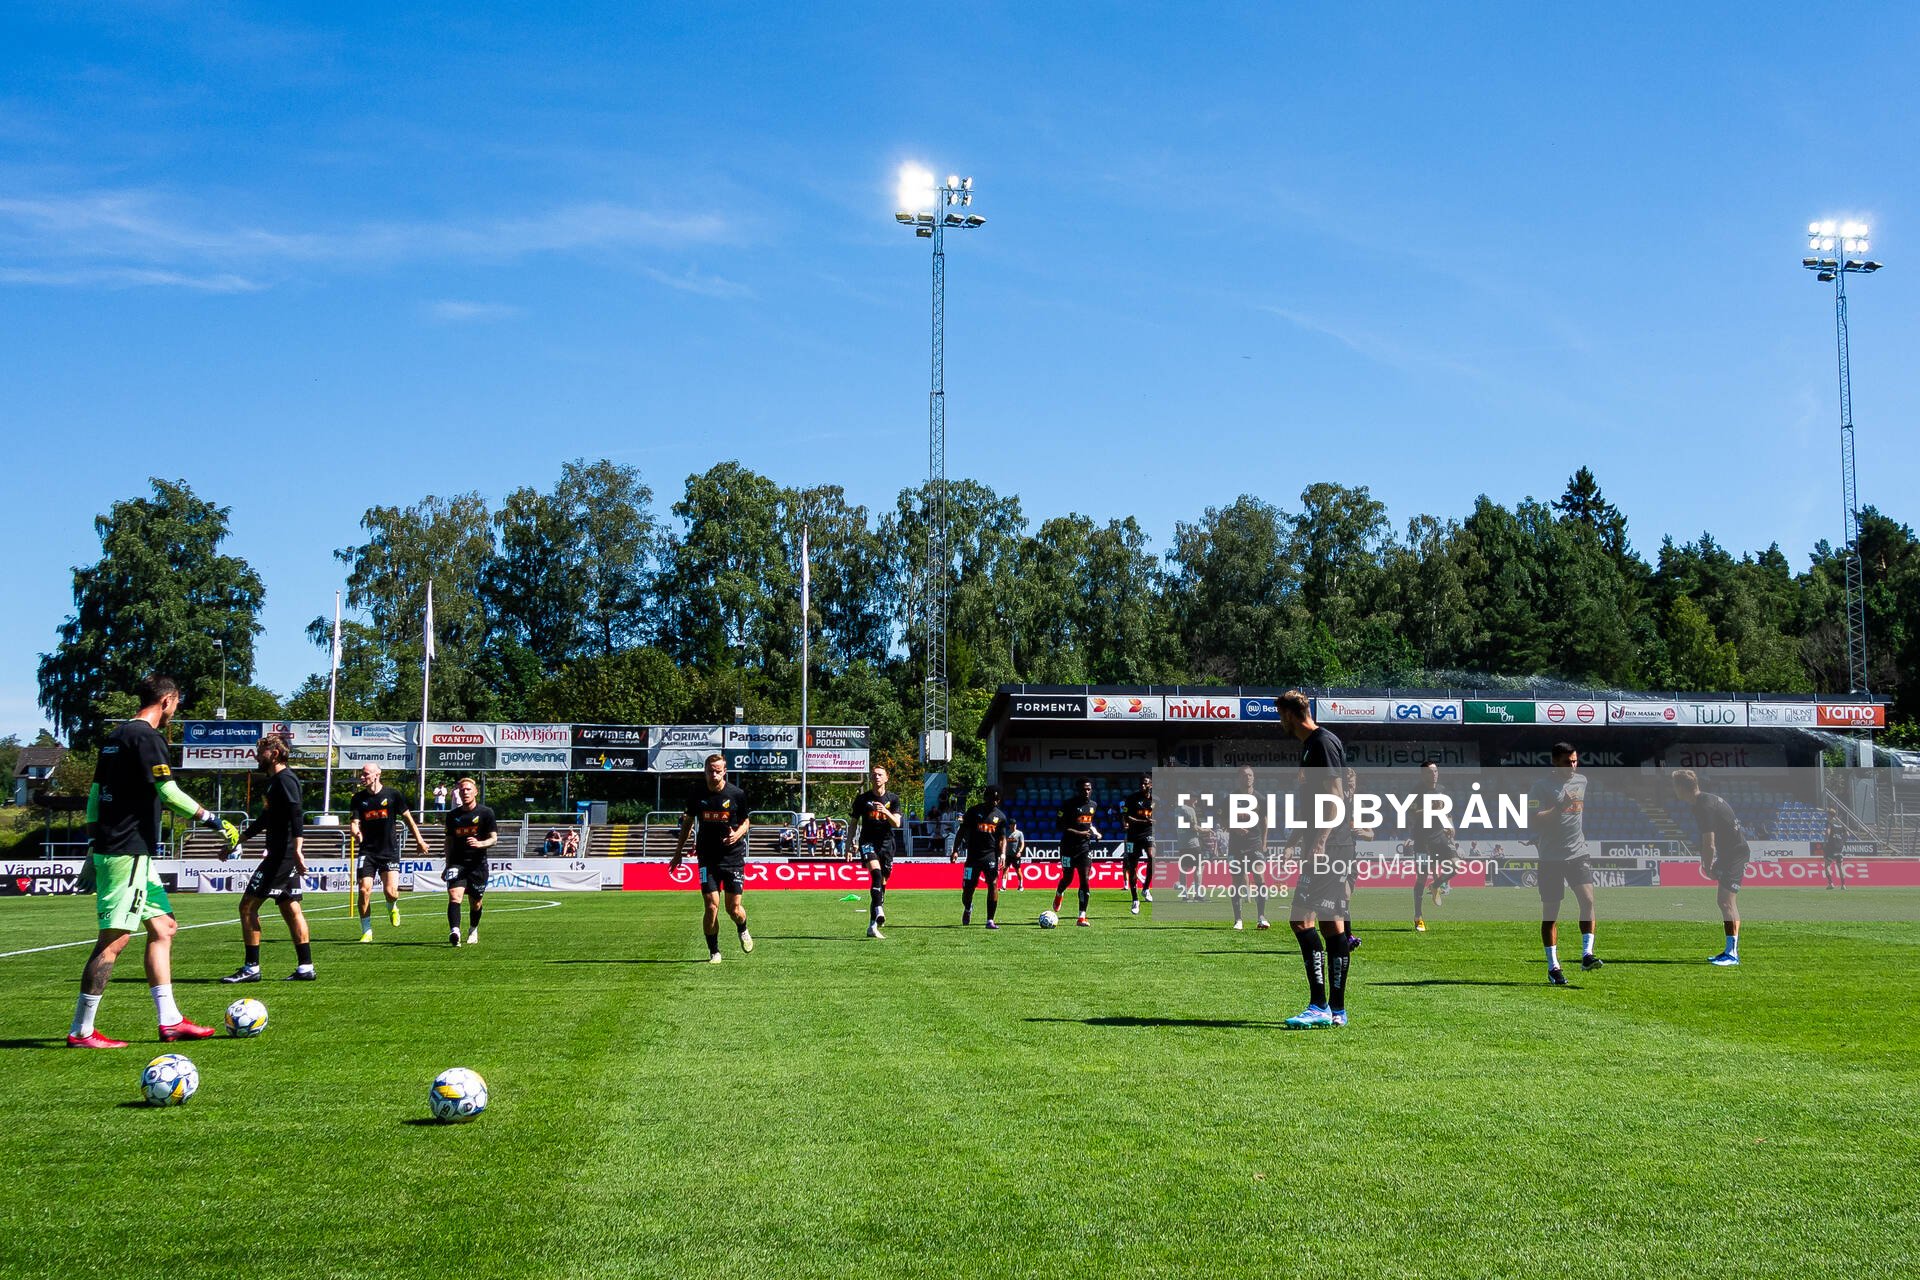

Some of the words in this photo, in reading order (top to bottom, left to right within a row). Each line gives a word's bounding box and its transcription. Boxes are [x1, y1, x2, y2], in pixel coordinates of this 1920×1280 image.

[1016, 703, 1080, 712] FORMENTA
[1338, 706, 1375, 716] Pinewood
[1486, 704, 1506, 714] hang
[452, 725, 466, 733] ICA
[816, 730, 866, 738] BEMANNINGS
[501, 728, 567, 743] BabyBjörn
[729, 731, 793, 742] Panasonic
[816, 739, 846, 747] POOLEN
[187, 749, 257, 759] HESTRA
[345, 752, 384, 761] Värnamo
[439, 751, 476, 761] amber
[806, 751, 841, 759] innvedens
[1049, 749, 1147, 761] PELTOR
[734, 752, 788, 768] golvabia
[833, 759, 866, 767] Transport
[5, 864, 74, 876] VärnaBo
[776, 864, 870, 881] OFFICE
